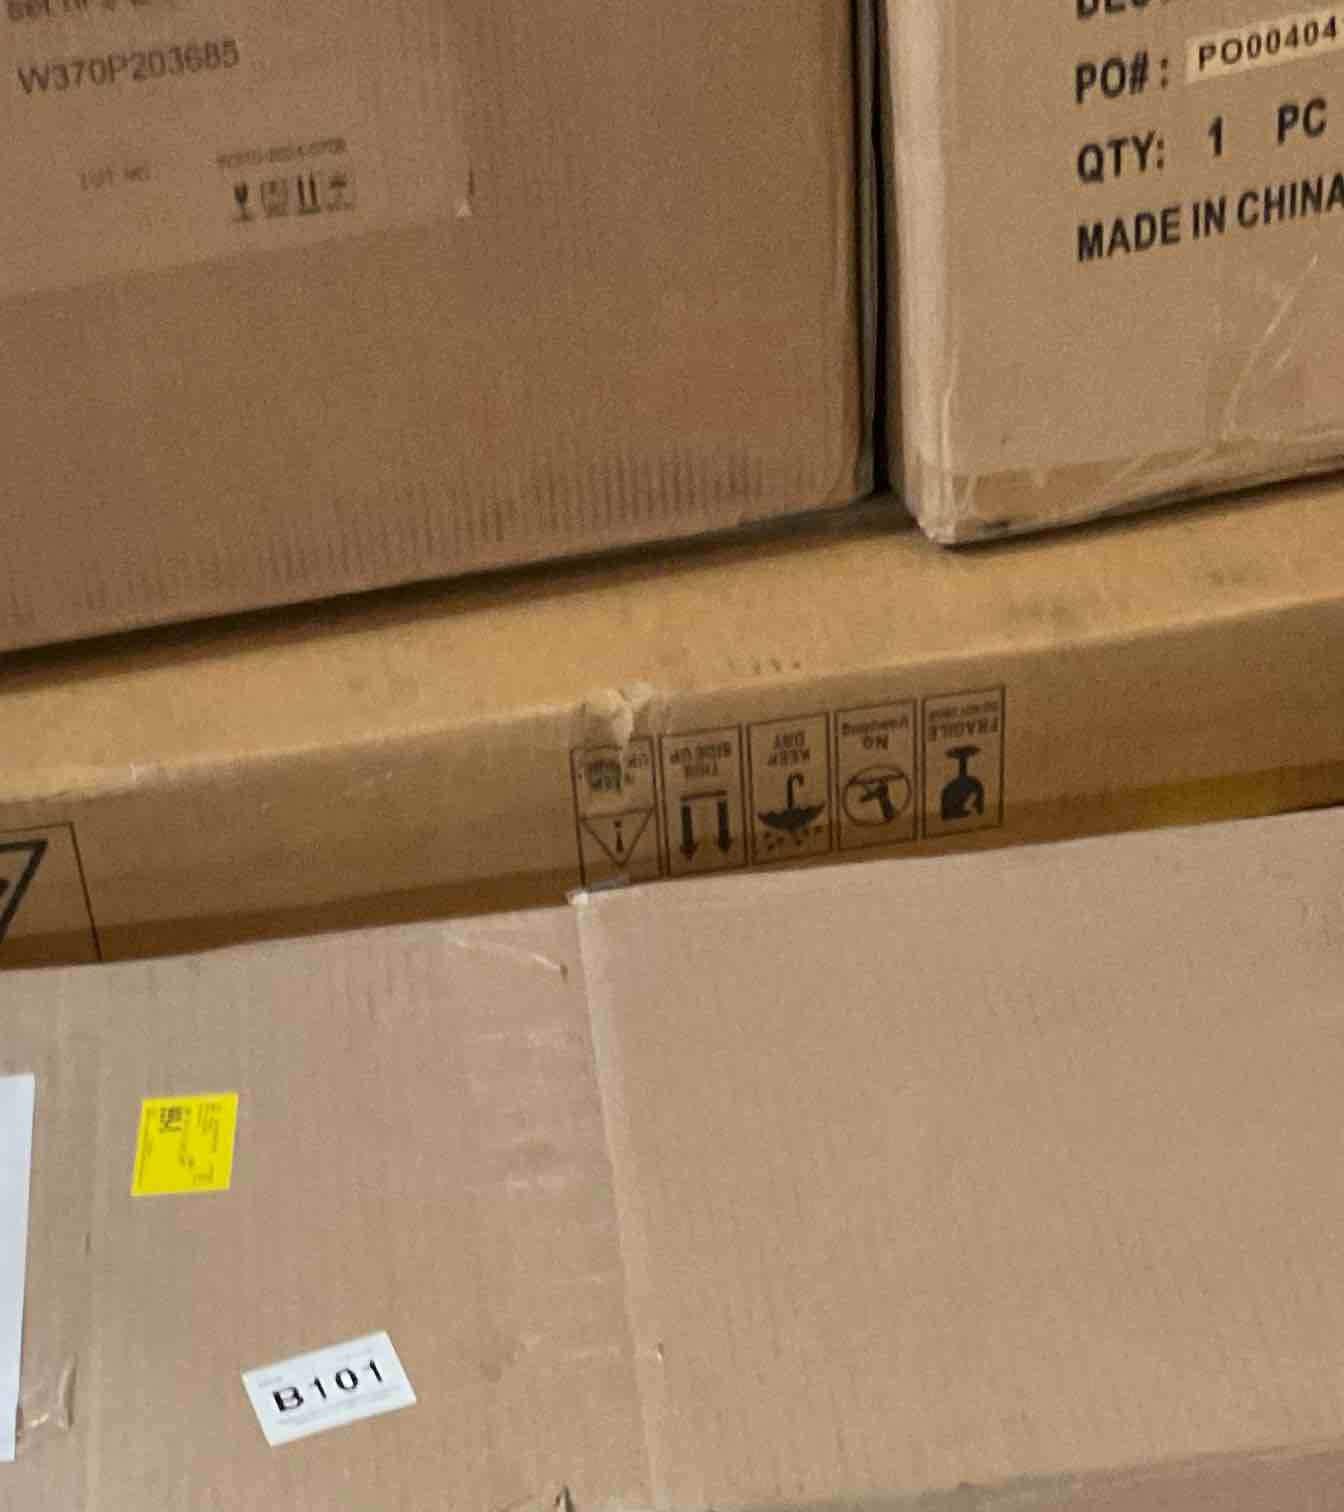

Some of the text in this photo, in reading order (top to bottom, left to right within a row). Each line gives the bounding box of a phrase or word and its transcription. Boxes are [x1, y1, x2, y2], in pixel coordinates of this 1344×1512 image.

[1076, 98, 1329, 184] QTY: 1 PC
[1076, 207, 1181, 263] MADE
[1191, 196, 1227, 242] IN
[272, 1358, 385, 1413] B101
